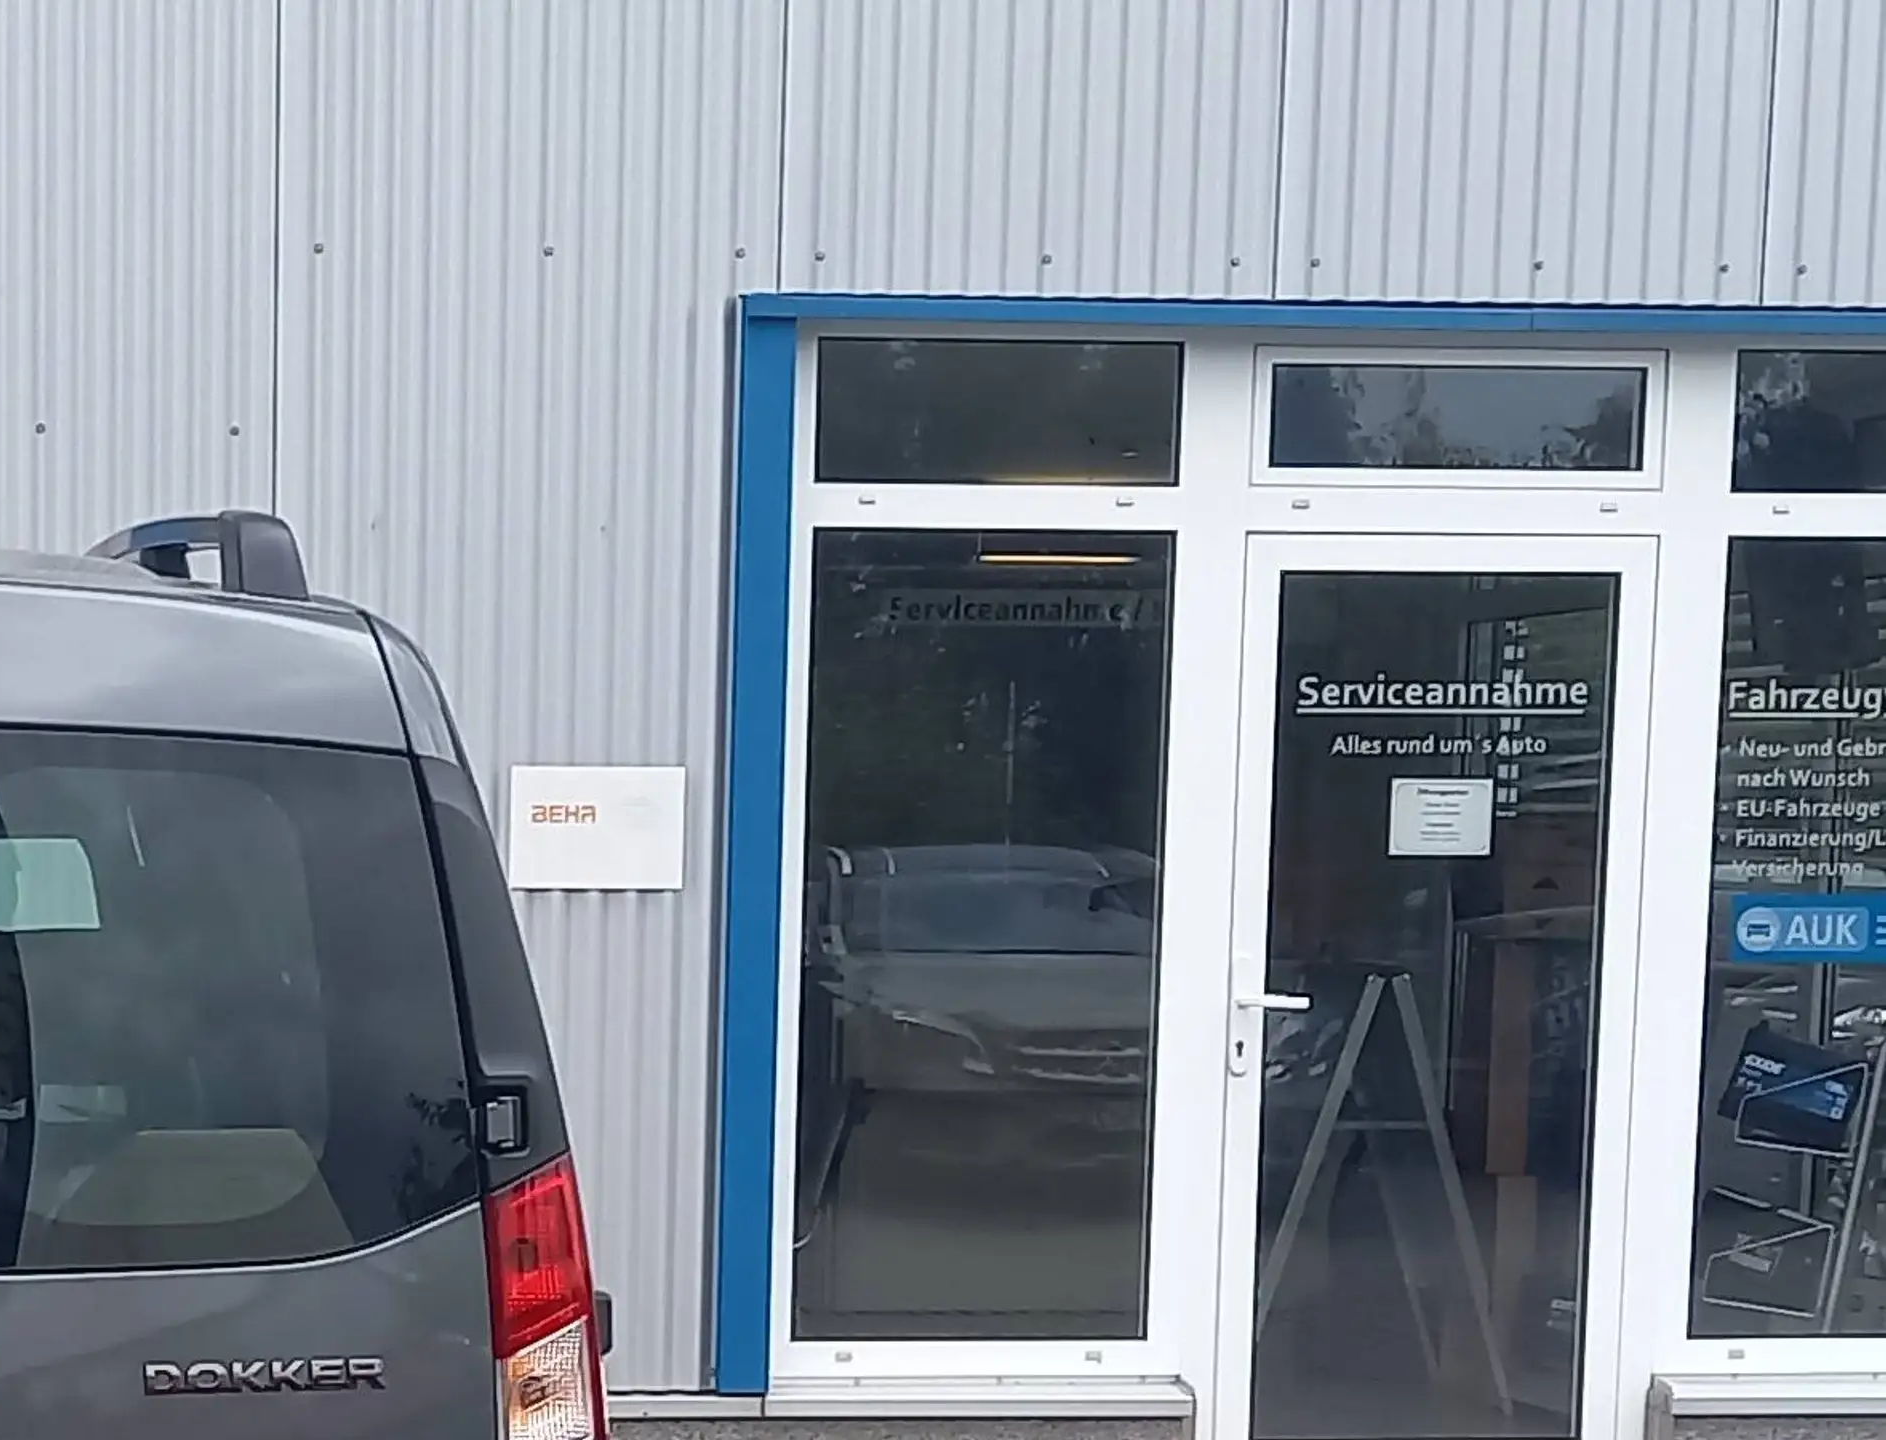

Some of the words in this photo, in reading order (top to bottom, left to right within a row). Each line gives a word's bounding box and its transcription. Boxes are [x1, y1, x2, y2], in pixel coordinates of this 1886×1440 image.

[1298, 673, 1589, 706] Serviceannahme
[1728, 678, 1886, 719] Fahrzeug
[1330, 734, 1381, 755] Alles
[1387, 734, 1435, 755] rund
[1496, 735, 1547, 756] Auto
[1739, 736, 1790, 757] Neu-
[1794, 737, 1833, 757] und
[1737, 765, 1786, 787] nach
[1790, 766, 1871, 787] Wunsch
[1736, 797, 1881, 822] EU-Fahrzeuge
[1732, 856, 1864, 880] Versicherung
[1785, 914, 1858, 946] AUK
[143, 1355, 386, 1395] DOKKER
